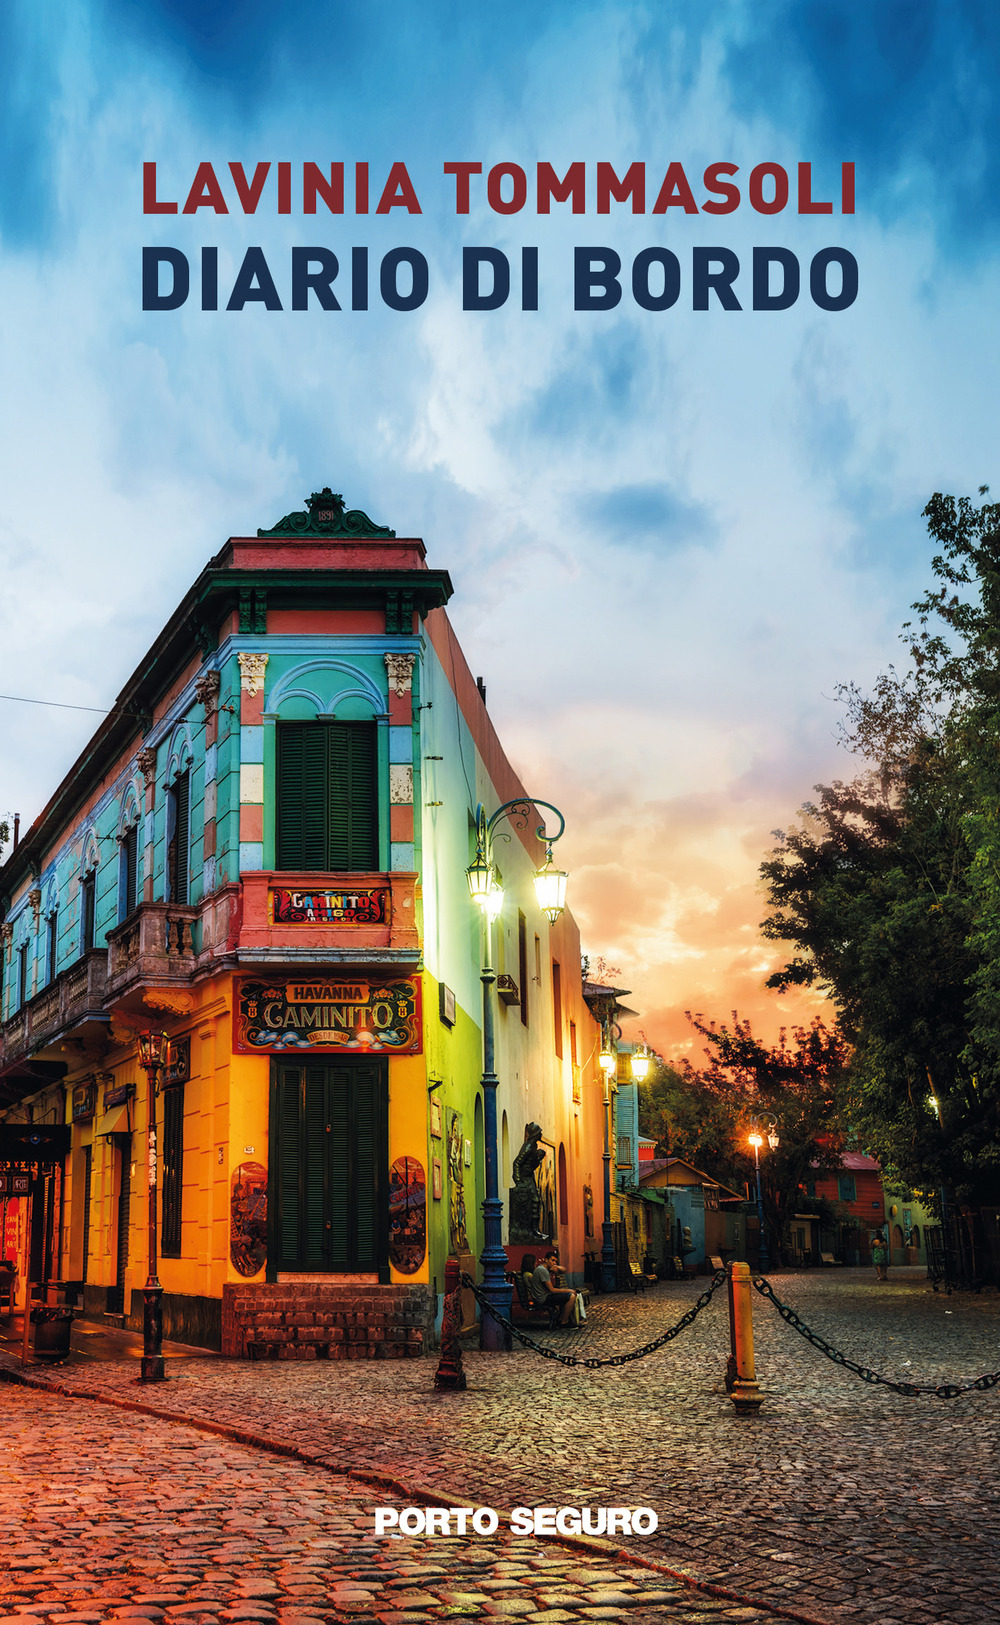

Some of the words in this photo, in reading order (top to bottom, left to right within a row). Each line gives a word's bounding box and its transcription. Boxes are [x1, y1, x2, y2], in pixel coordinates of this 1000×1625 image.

[318, 510, 334, 521] 1891
[307, 908, 355, 918] AMIGO
[293, 986, 364, 1001] HAVANNA
[263, 1001, 394, 1029] CAMINITO
